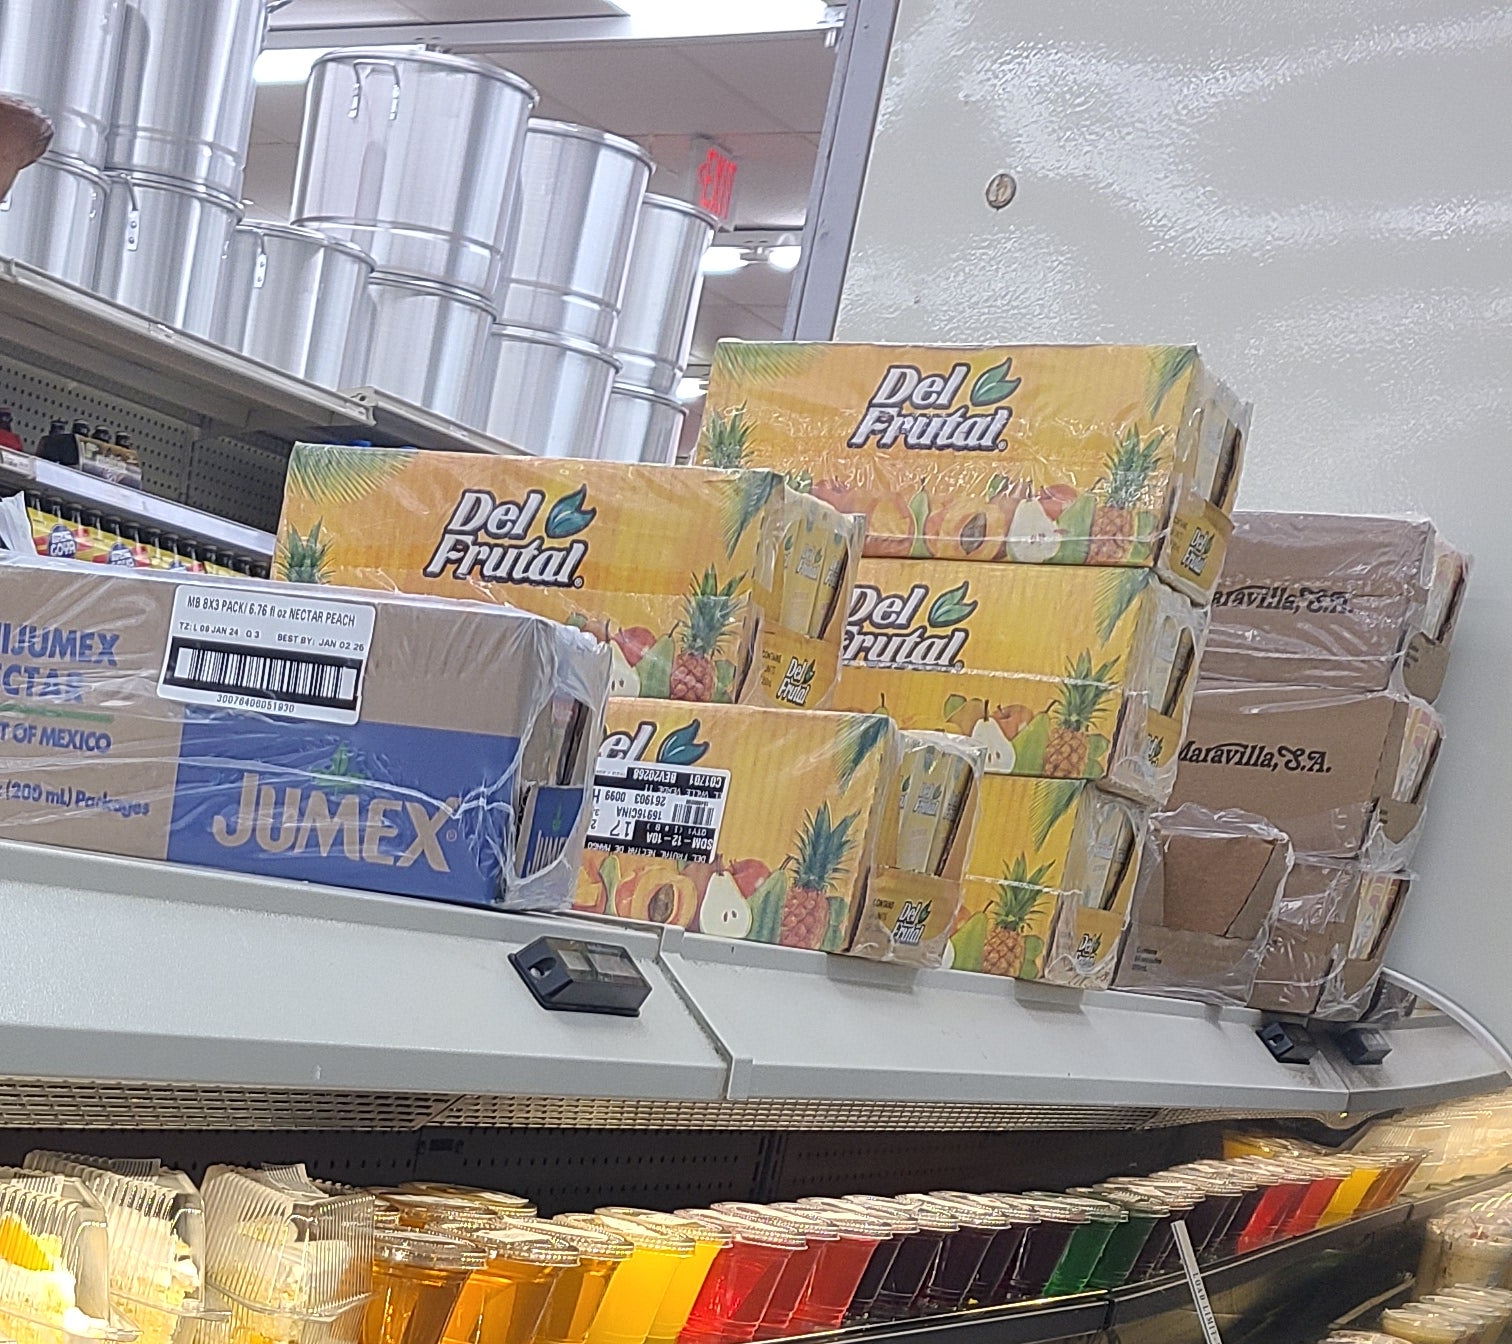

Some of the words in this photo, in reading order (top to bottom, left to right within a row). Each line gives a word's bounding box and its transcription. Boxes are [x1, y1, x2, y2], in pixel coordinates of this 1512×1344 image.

[869, 362, 972, 410] Del
[846, 404, 1013, 451] Frutal
[446, 488, 546, 540] Del
[50, 540, 77, 556] GOYA
[422, 533, 588, 587] Frutal
[187, 595, 201, 610] MB
[203, 597, 220, 612] 8X3
[248, 603, 268, 617] 6.76
[288, 607, 324, 623] NECTAR
[325, 612, 356, 627] PEACH
[847, 583, 930, 628] Del
[1210, 584, 1302, 615] aravilla,
[211, 625, 228, 636] JAN
[228, 627, 239, 637] 24
[253, 630, 260, 639] 3
[277, 633, 298, 645] BEST
[318, 638, 337, 649] JAN
[339, 640, 351, 650] 02
[785, 655, 809, 683] Del
[775, 677, 812, 707] Frutal
[13, 722, 37, 743] OF
[39, 727, 113, 754] MEXICO
[45, 788, 73, 808] mL)
[605, 789, 627, 803] 0099
[634, 793, 667, 807] 261903
[212, 772, 459, 873] JUMEX
[609, 820, 633, 838] 17
[899, 900, 921, 924] Del
[1192, 1272, 1206, 1302] LOAD
[1202, 1303, 1218, 1337] LIMIT
